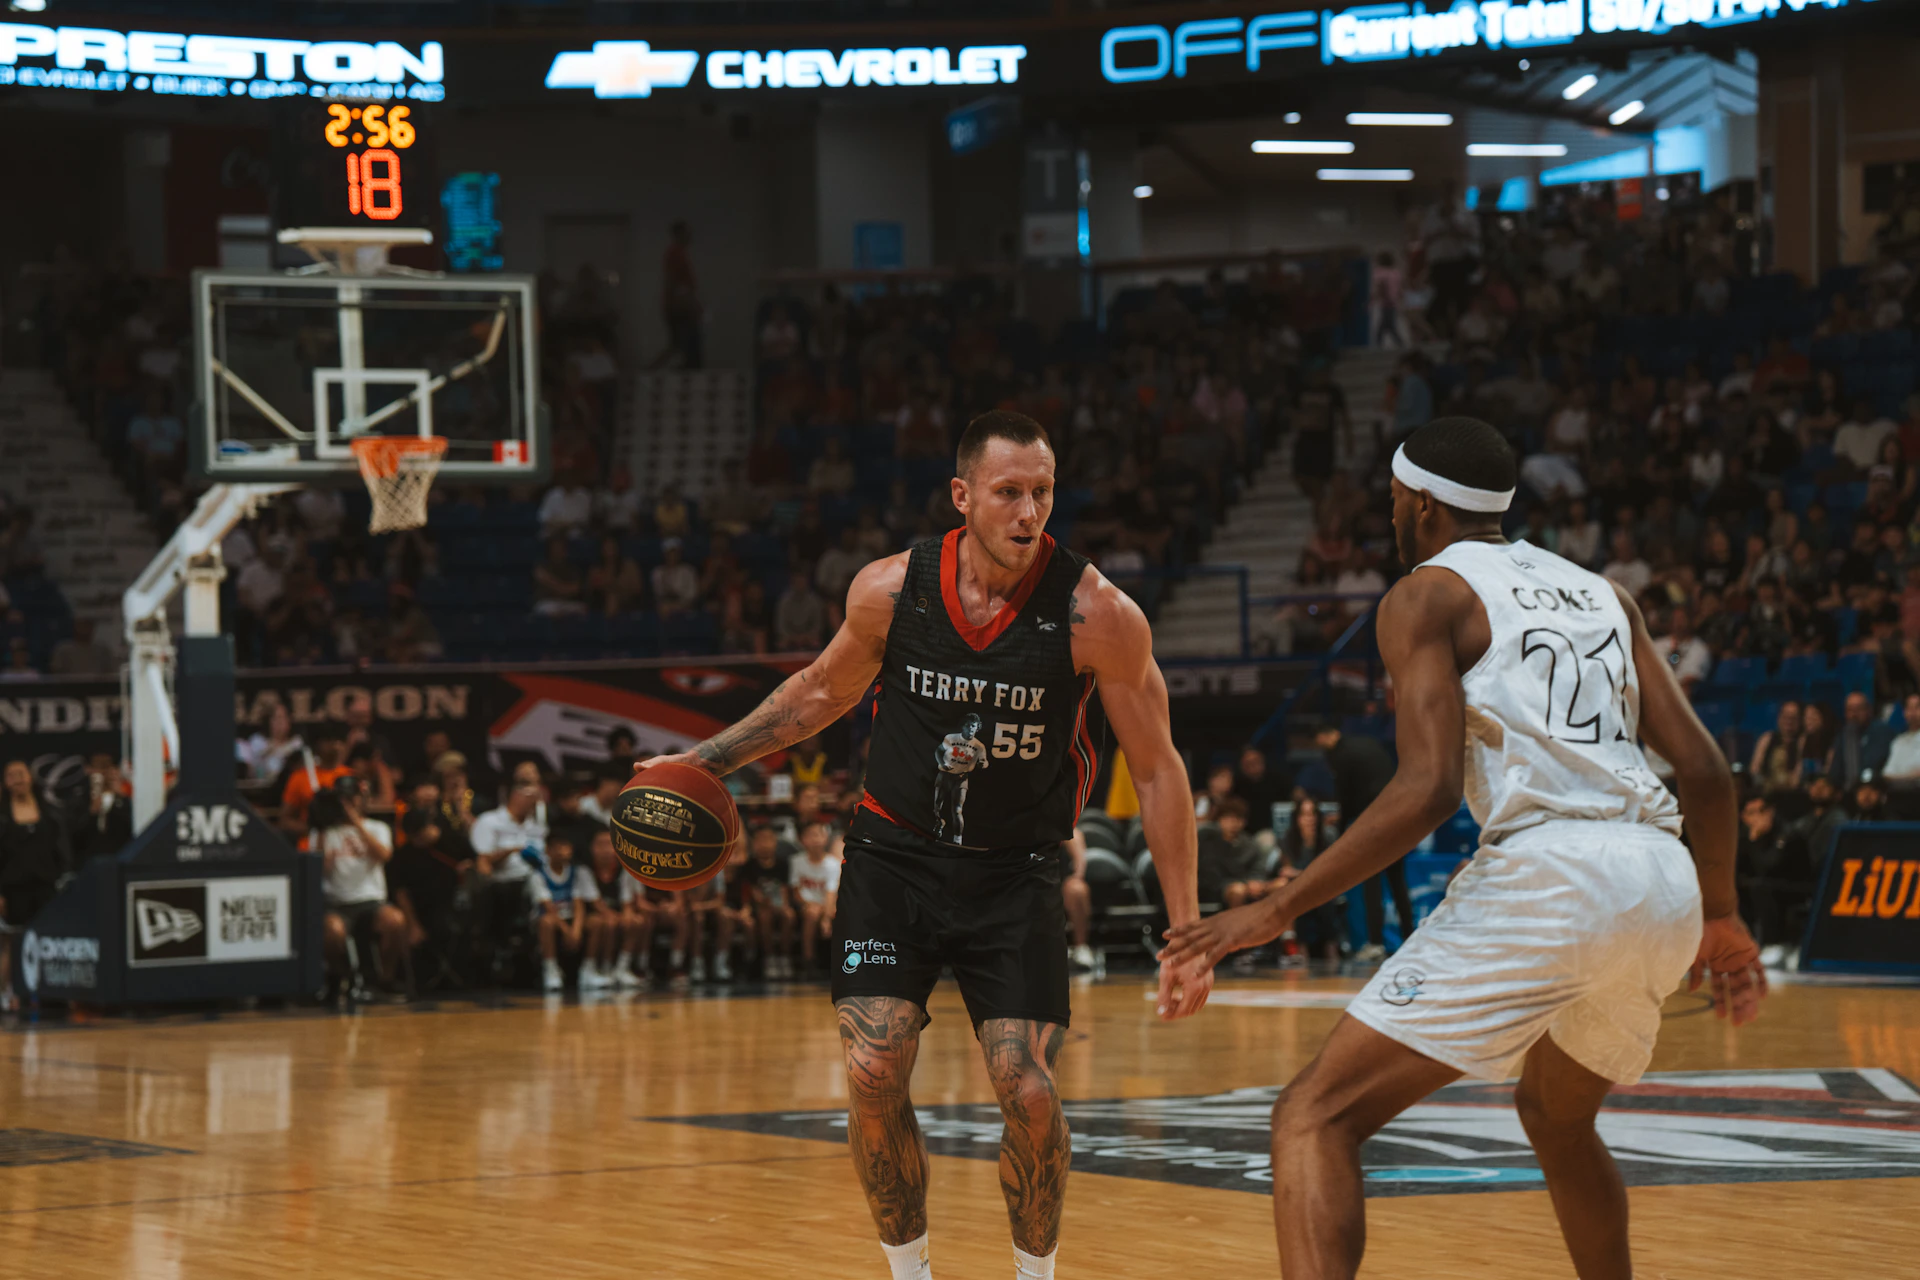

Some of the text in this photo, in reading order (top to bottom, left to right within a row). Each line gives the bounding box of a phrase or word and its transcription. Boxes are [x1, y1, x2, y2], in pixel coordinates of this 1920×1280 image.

[1330, 5, 1478, 57] Current
[1480, 0, 1583, 46] Total
[0, 22, 445, 83] PRESTON
[706, 44, 1027, 89] CHEVROLET
[325, 103, 416, 148] 2:56
[346, 148, 403, 220] 18
[1511, 587, 1603, 612] COKE
[906, 664, 1046, 713] TERRY FOX
[1522, 627, 1631, 744] 21
[991, 722, 1046, 761] 55
[621, 805, 697, 839] LEGACY
[615, 828, 694, 869] SPALDING
[1830, 855, 1920, 919] LiU
[844, 938, 897, 953] Perfect
[863, 952, 897, 966] Lens
